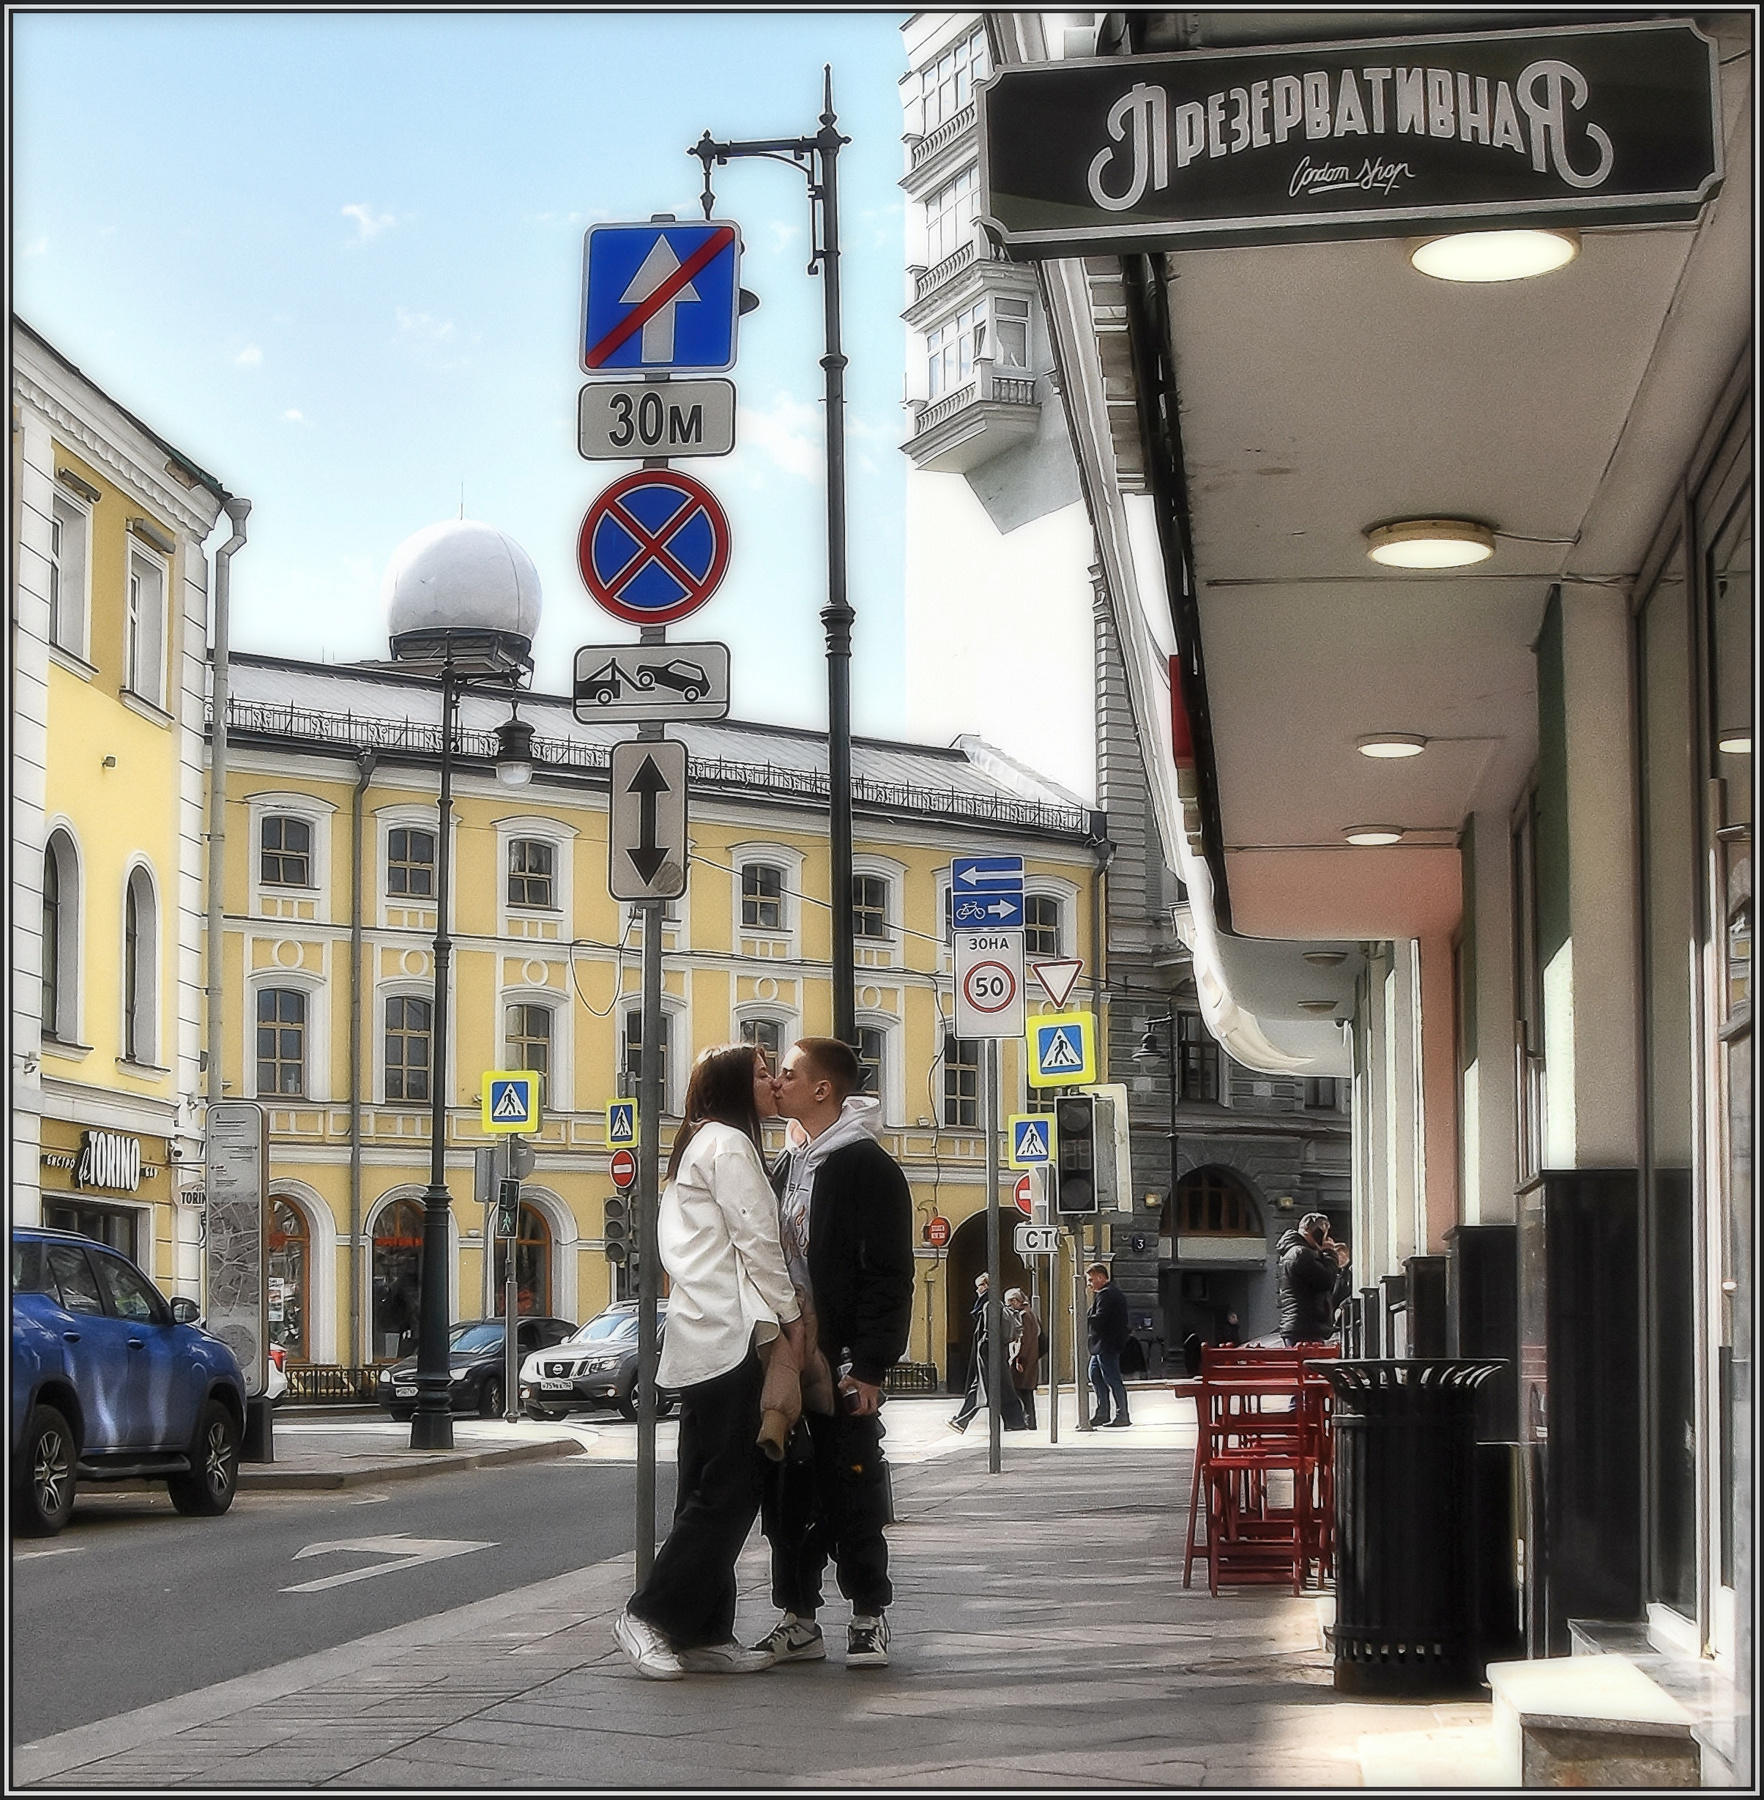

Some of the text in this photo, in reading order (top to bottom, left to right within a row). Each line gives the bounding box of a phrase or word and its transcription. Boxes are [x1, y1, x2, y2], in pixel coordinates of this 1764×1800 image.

[968, 937, 1010, 951] ЗОНА
[975, 976, 1004, 997] 50
[89, 1130, 141, 1192] TORINO
[1137, 1239, 1144, 1250] 3
